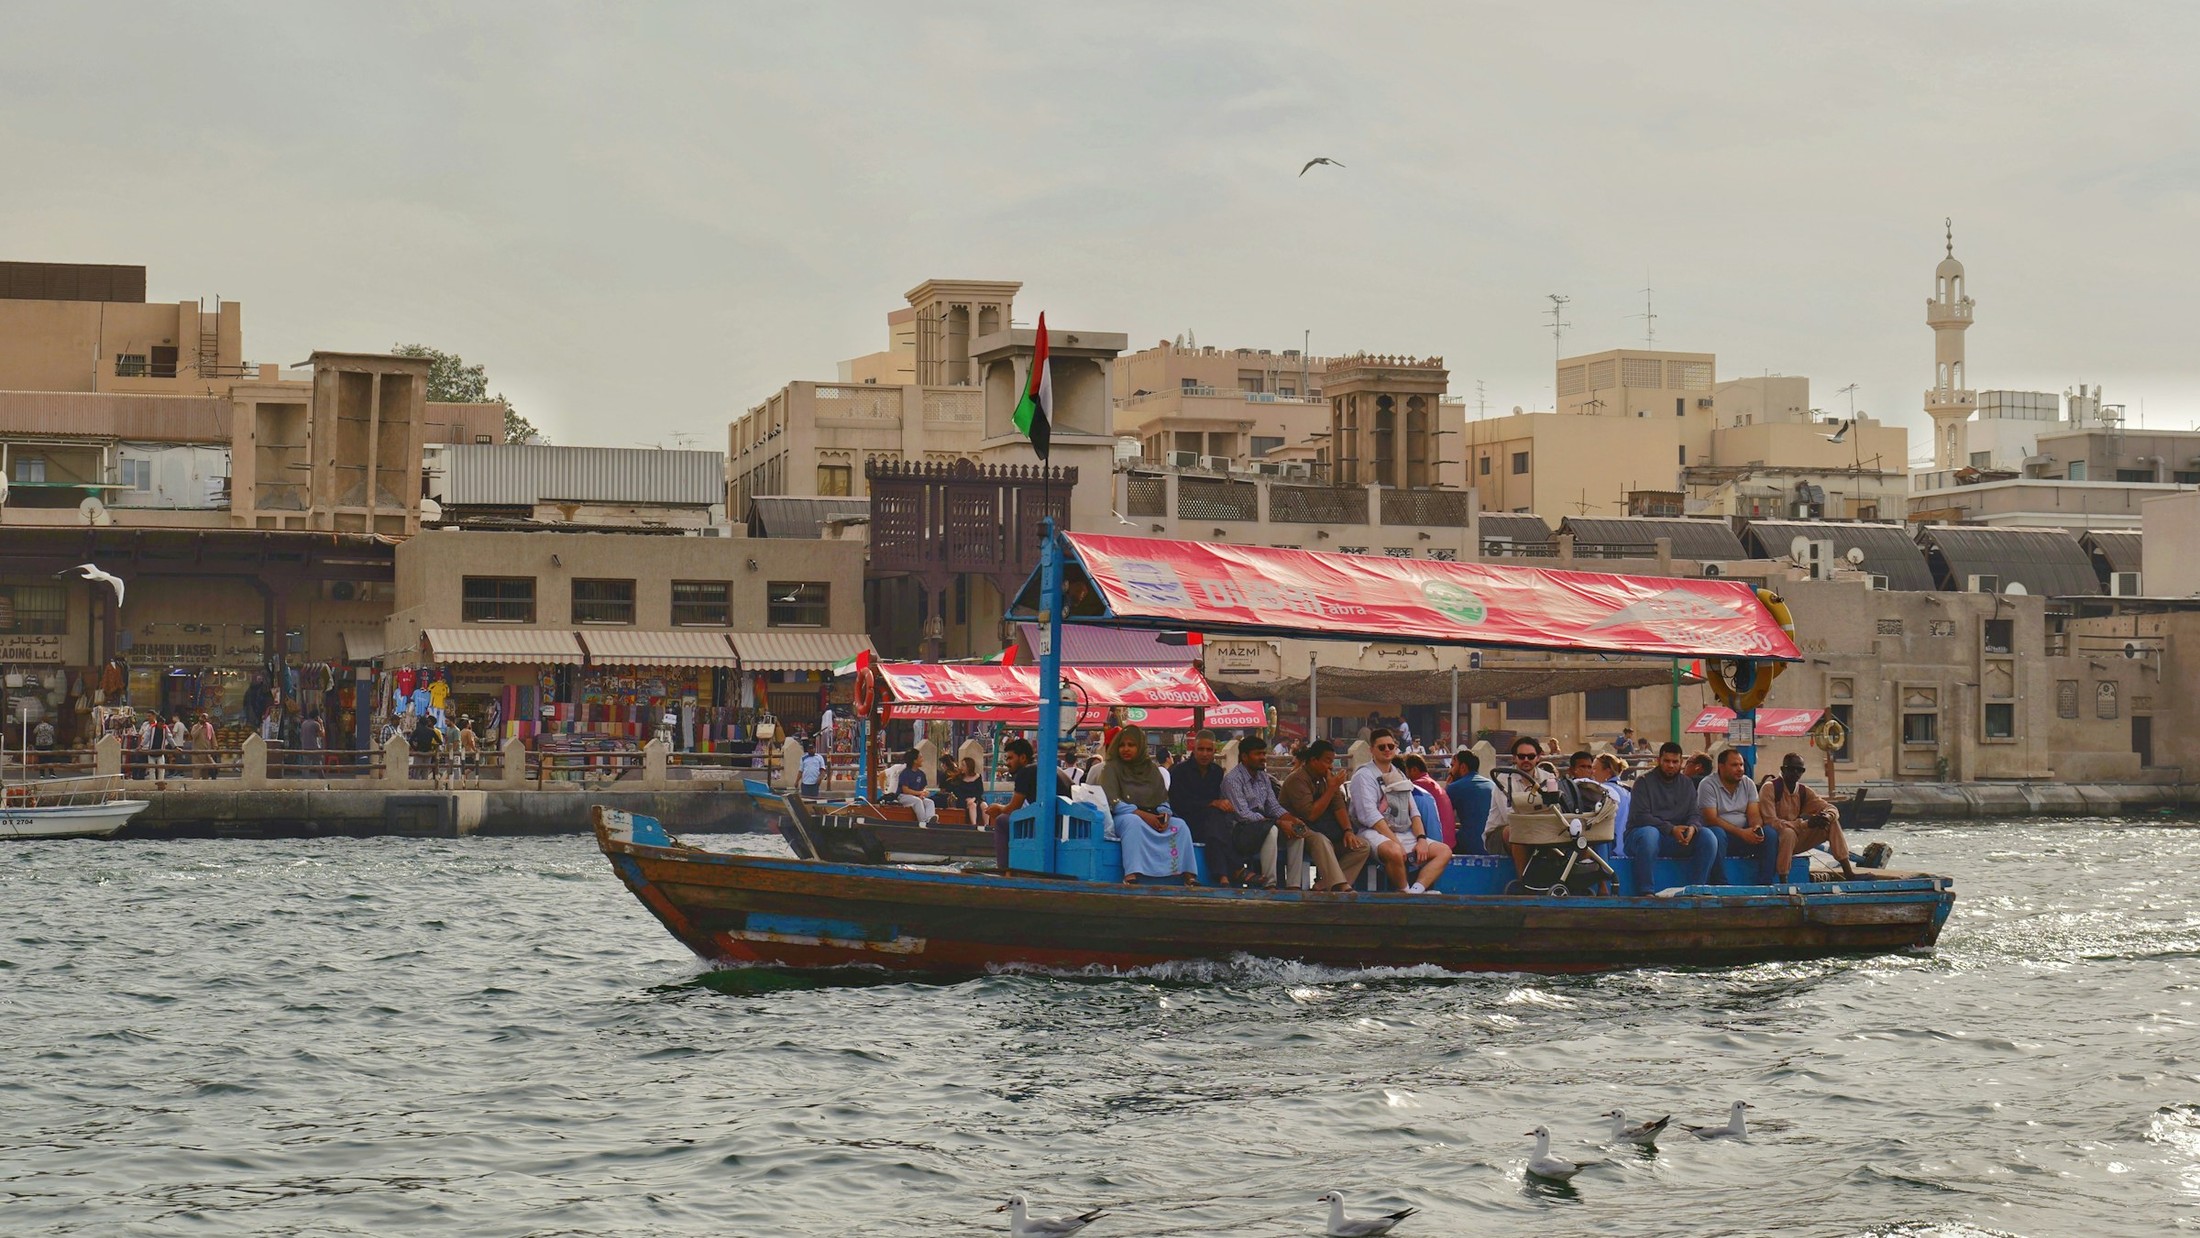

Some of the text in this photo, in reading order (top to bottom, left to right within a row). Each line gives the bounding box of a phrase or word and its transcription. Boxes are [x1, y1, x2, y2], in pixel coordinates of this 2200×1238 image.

[1328, 603, 1367, 615] abra
[0, 648, 58, 659] ADING L.L.C
[177, 644, 216, 655] NASERI
[1377, 647, 1418, 658] مازمي
[455, 675, 504, 684] PREME
[1148, 691, 1208, 702] 8009090
[893, 705, 933, 714] DUBAI
[1210, 716, 1260, 725] 8009090
